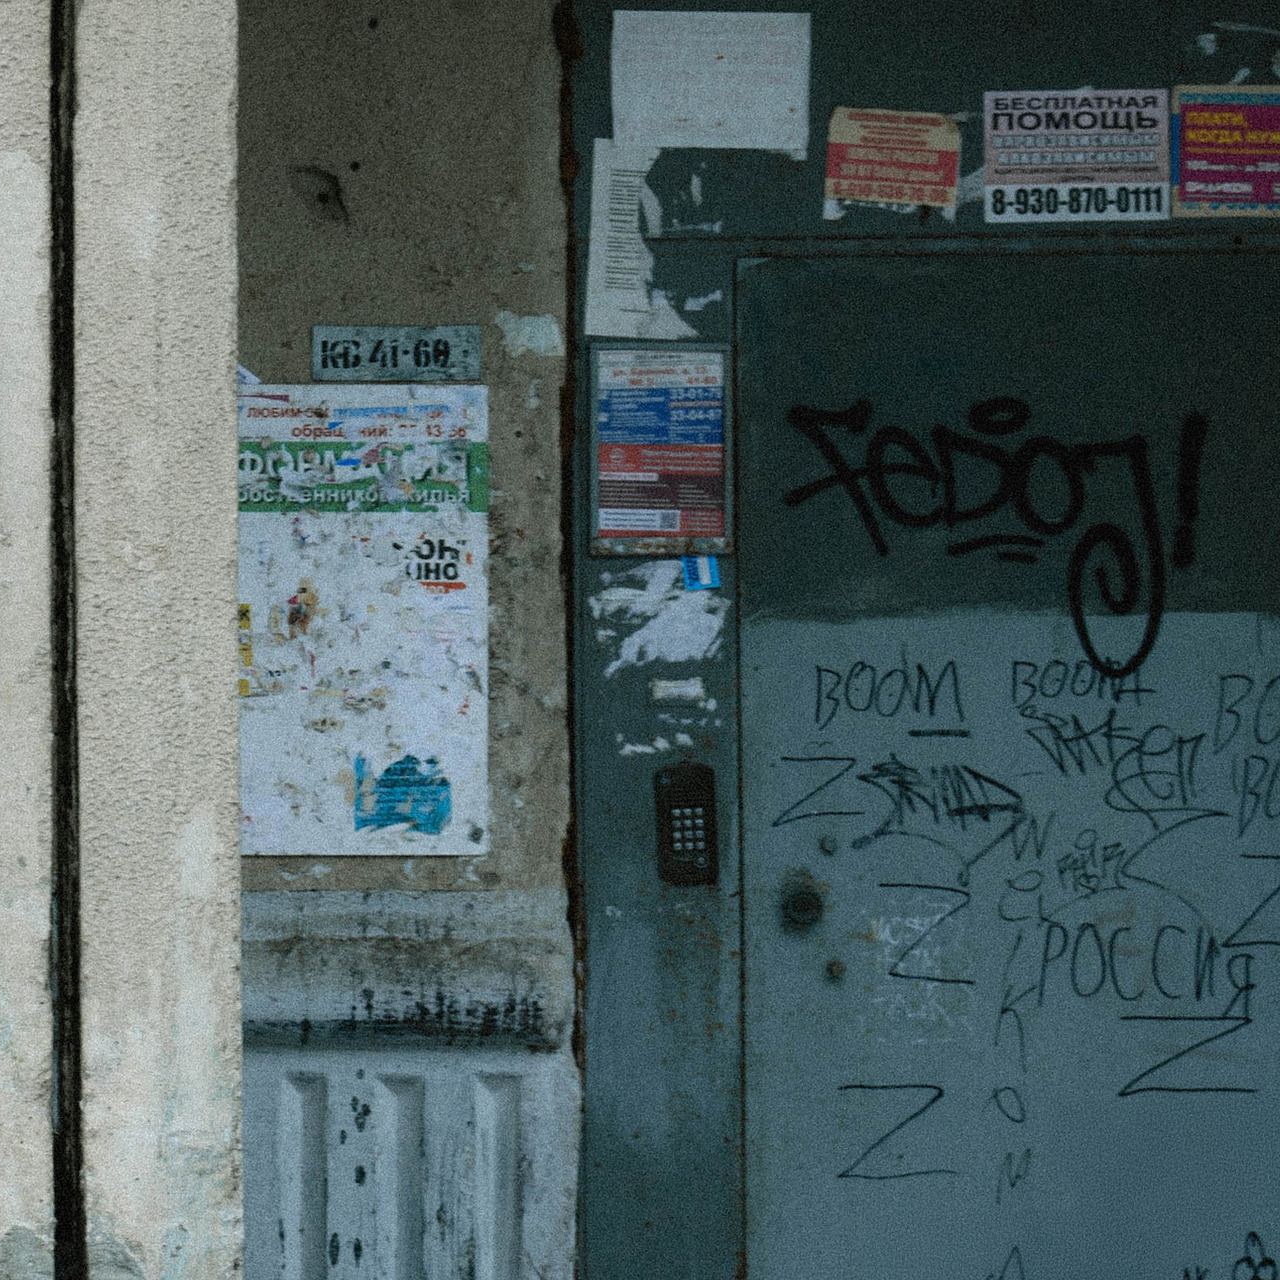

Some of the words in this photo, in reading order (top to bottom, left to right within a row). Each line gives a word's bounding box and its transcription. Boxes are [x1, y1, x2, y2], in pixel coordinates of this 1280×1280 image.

[994, 97, 1158, 110] БЕСПЛАТНАЯ
[992, 111, 1159, 131] ПОМОЩЬ
[992, 187, 1162, 214] 8-930-870-0111
[1037, 920, 1256, 1021] РОССИЯ
